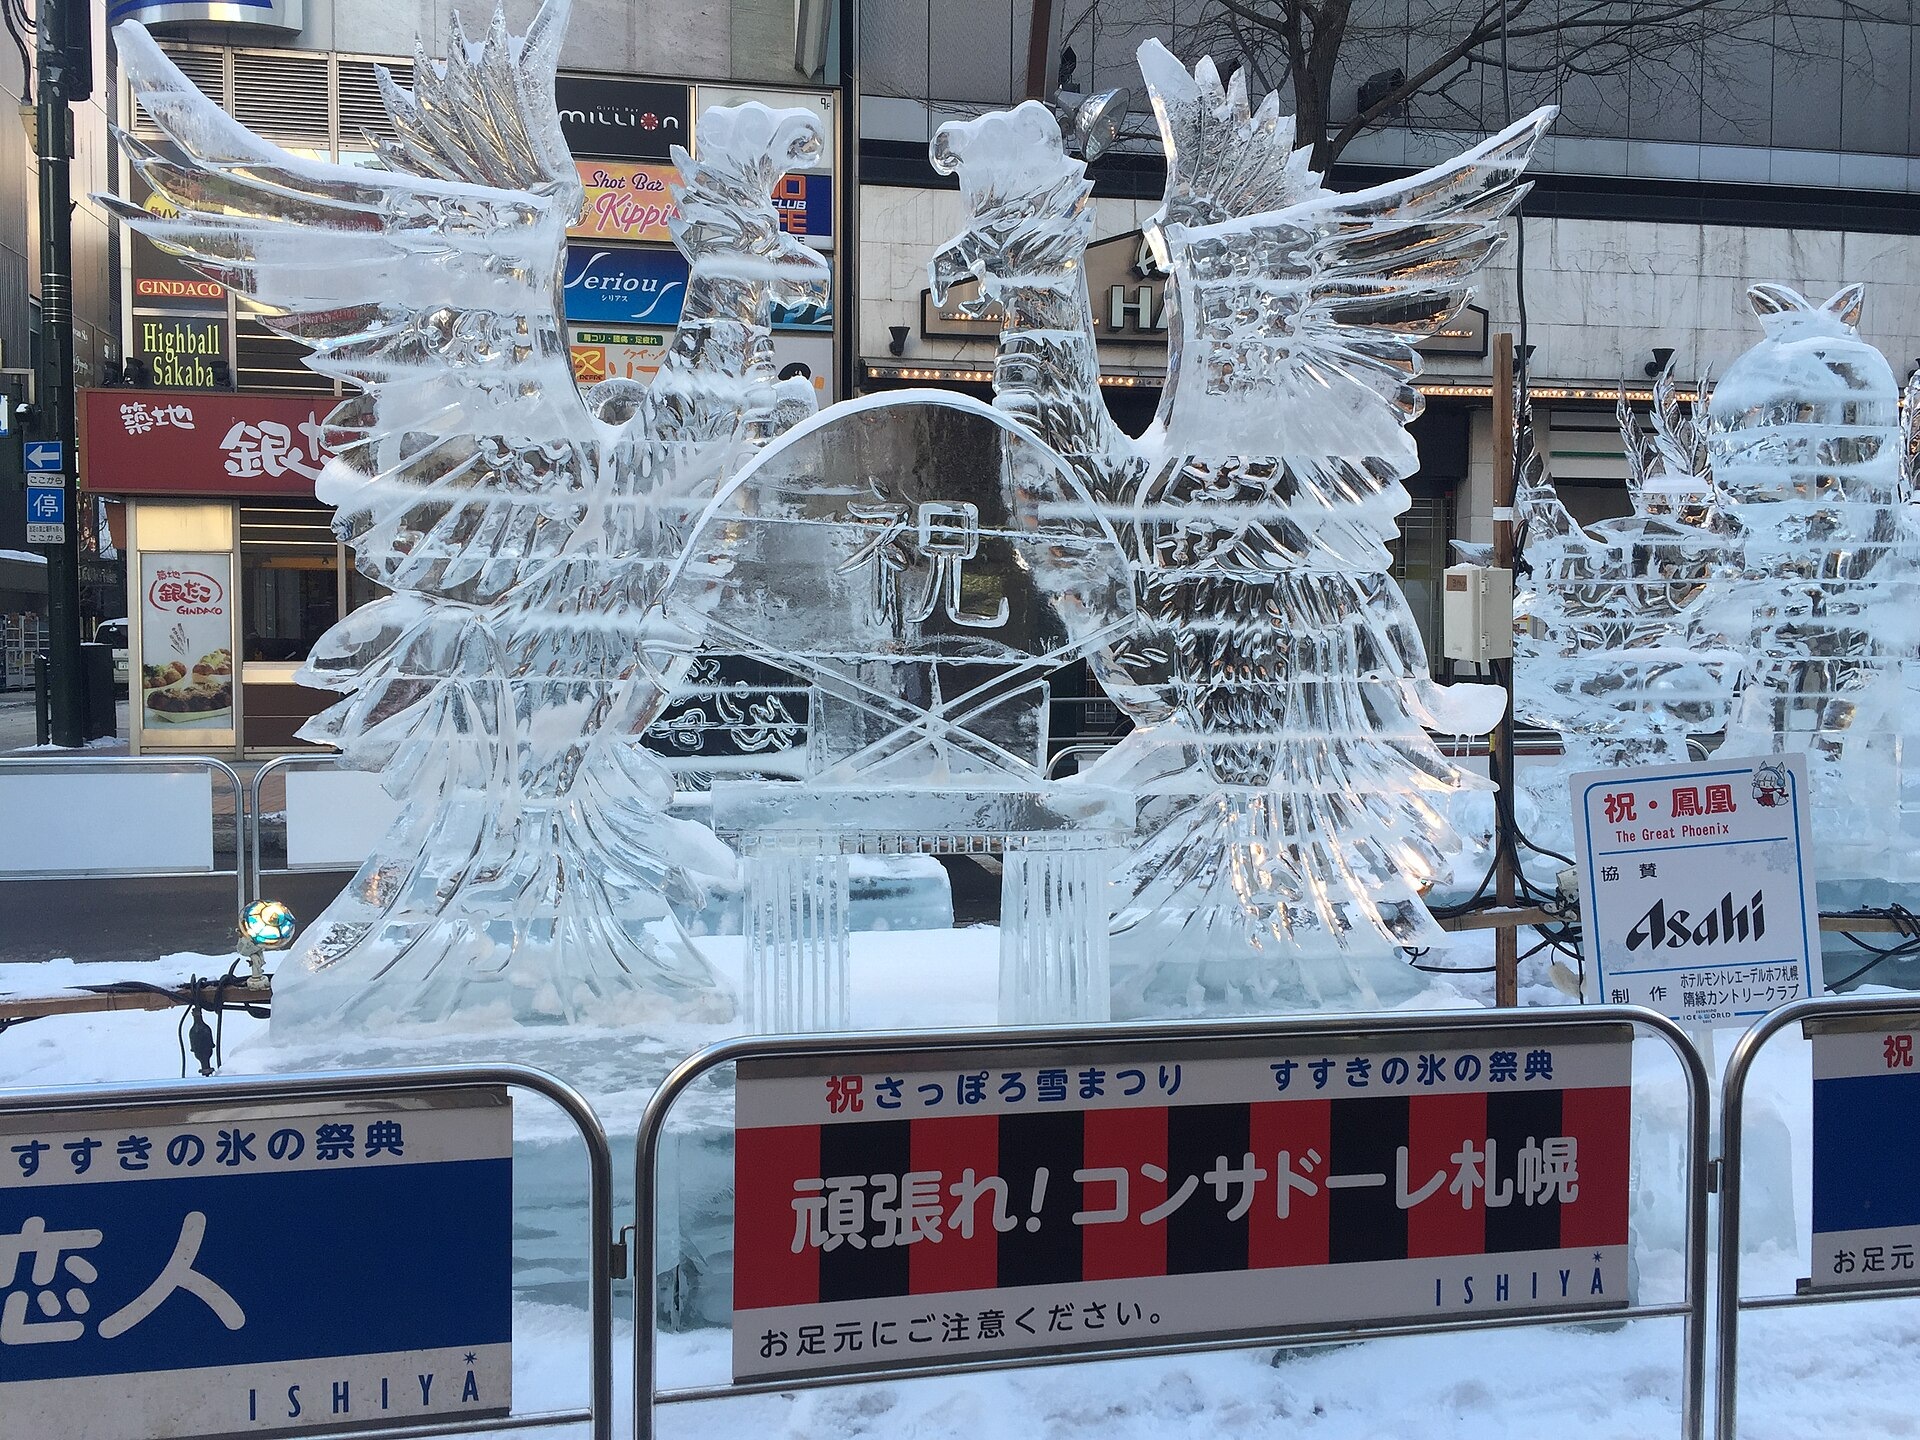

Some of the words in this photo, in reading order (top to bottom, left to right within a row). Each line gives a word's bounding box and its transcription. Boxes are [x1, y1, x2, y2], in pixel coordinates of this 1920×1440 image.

[586, 170, 626, 189] Shot
[631, 173, 665, 191] Bar
[139, 280, 222, 297] GINDACO
[563, 252, 683, 318] Serious
[601, 294, 629, 303] シリアス
[143, 323, 220, 363] Highball
[153, 356, 215, 387] Sakaba
[120, 401, 196, 436] 築地
[30, 476, 63, 485] ここから
[33, 494, 59, 517] 停
[158, 579, 211, 603] 銀だこ
[1603, 783, 1737, 824] 祝・鳳凰
[1615, 829, 1637, 843] The
[1641, 826, 1676, 841] Great
[1681, 822, 1730, 838] Phoenix
[1625, 889, 1764, 952] Asahi
[1883, 1034, 1914, 1069] 祝
[1270, 1049, 1554, 1092] すすきの氷の祭典
[11, 1120, 405, 1178] すすきの氷の祭典
[1833, 1244, 1915, 1274] お足元
[1435, 1266, 1604, 1306] ISHIYA
[759, 1301, 1160, 1358] お足元にご注意ください。
[248, 1369, 480, 1421] ISHIYA
